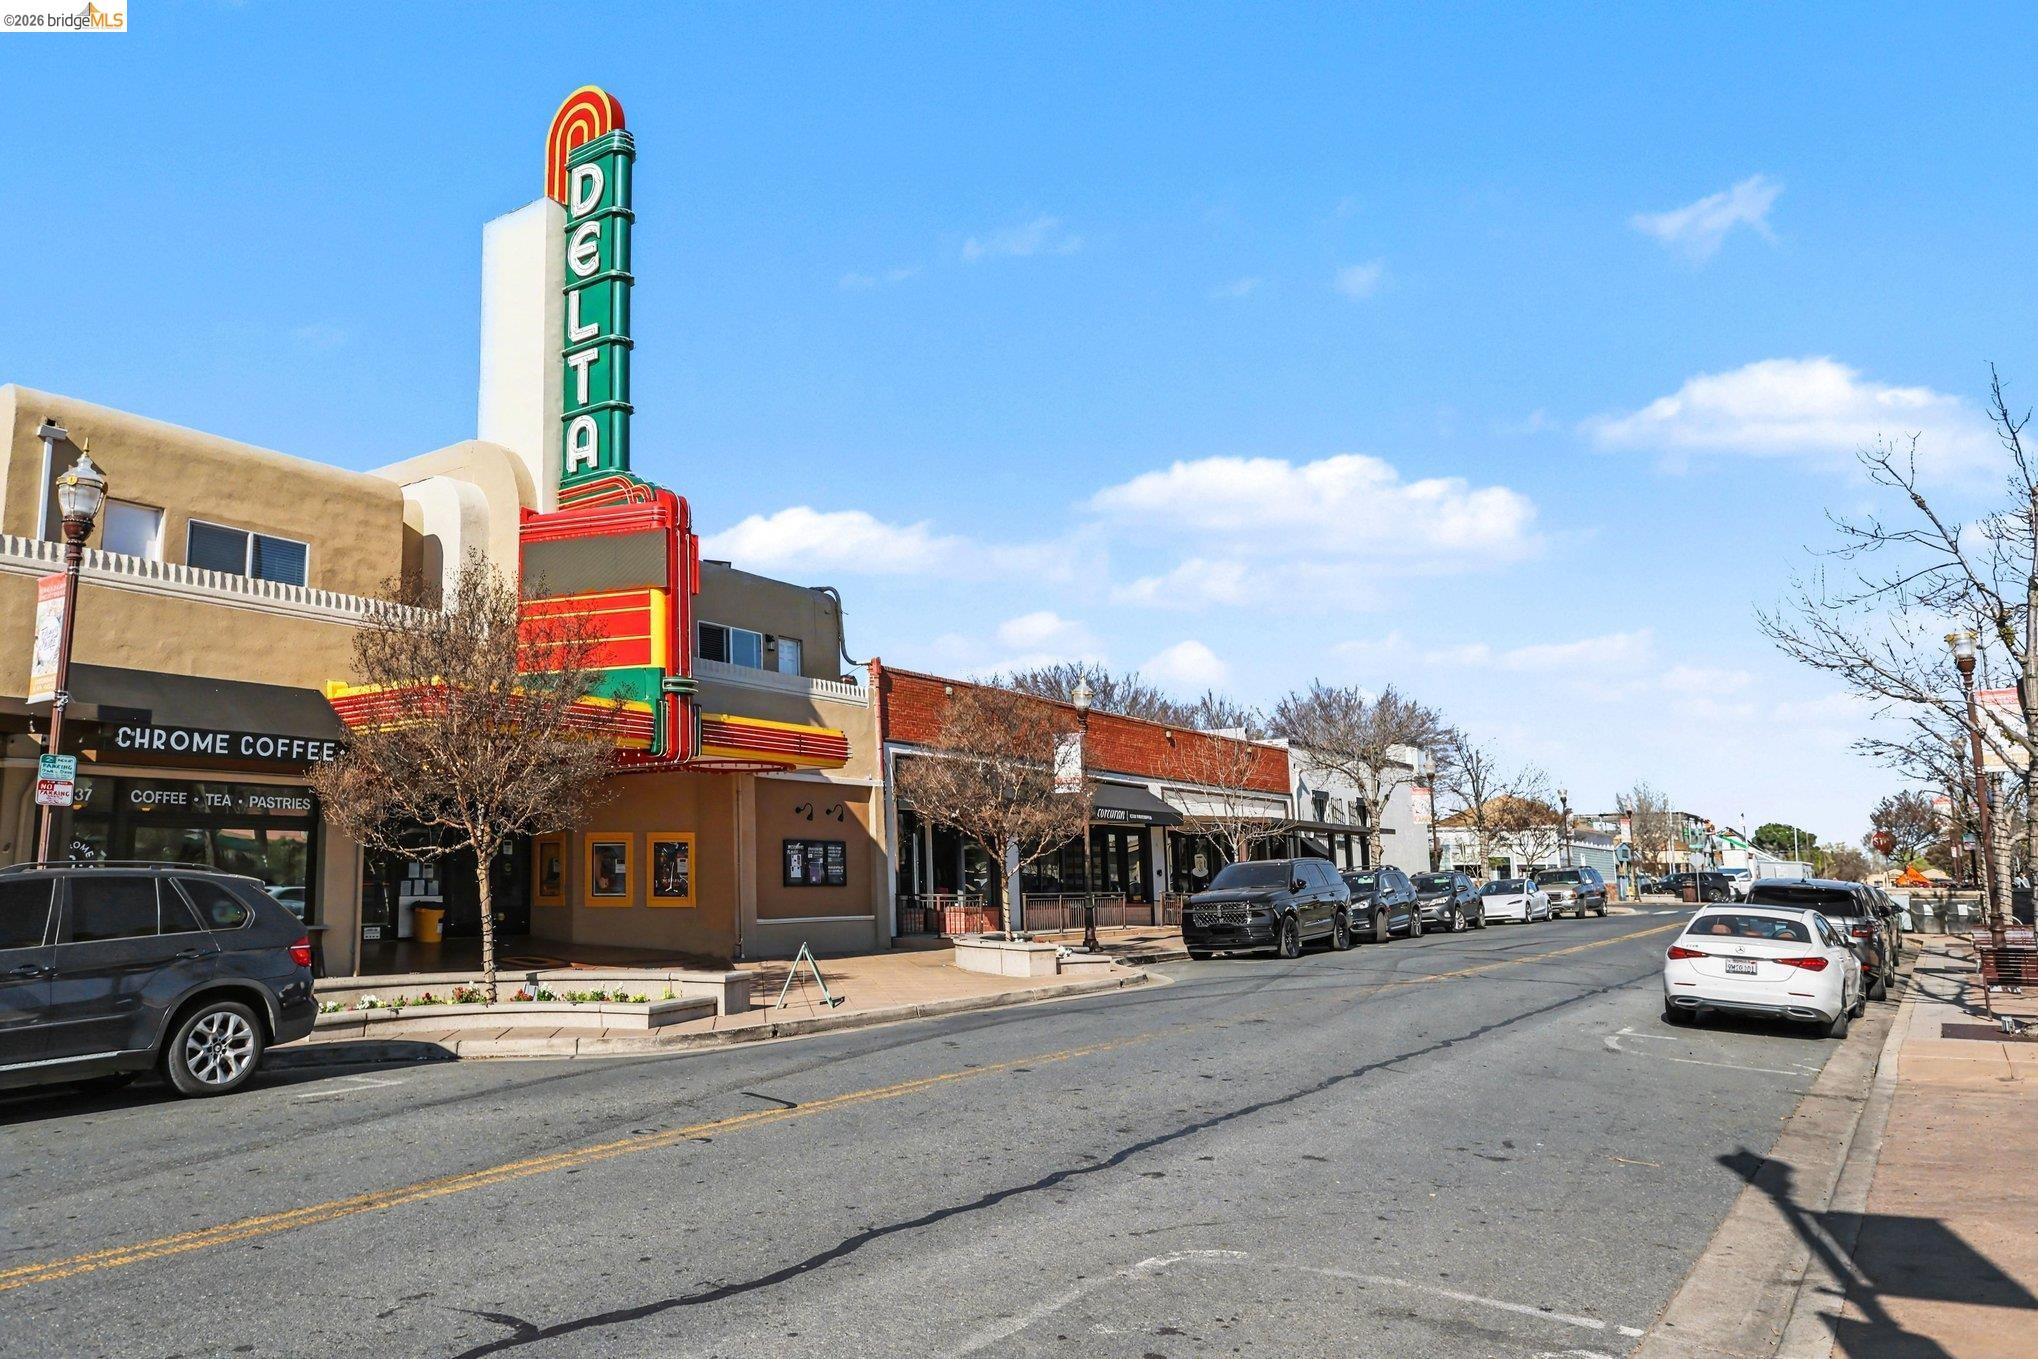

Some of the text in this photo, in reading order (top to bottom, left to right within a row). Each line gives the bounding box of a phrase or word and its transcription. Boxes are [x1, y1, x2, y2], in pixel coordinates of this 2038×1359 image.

[566, 162, 604, 474] DELTA
[117, 726, 335, 761] CHROME COFFEE
[131, 789, 311, 811] COFFEE TEA PASTRIES
